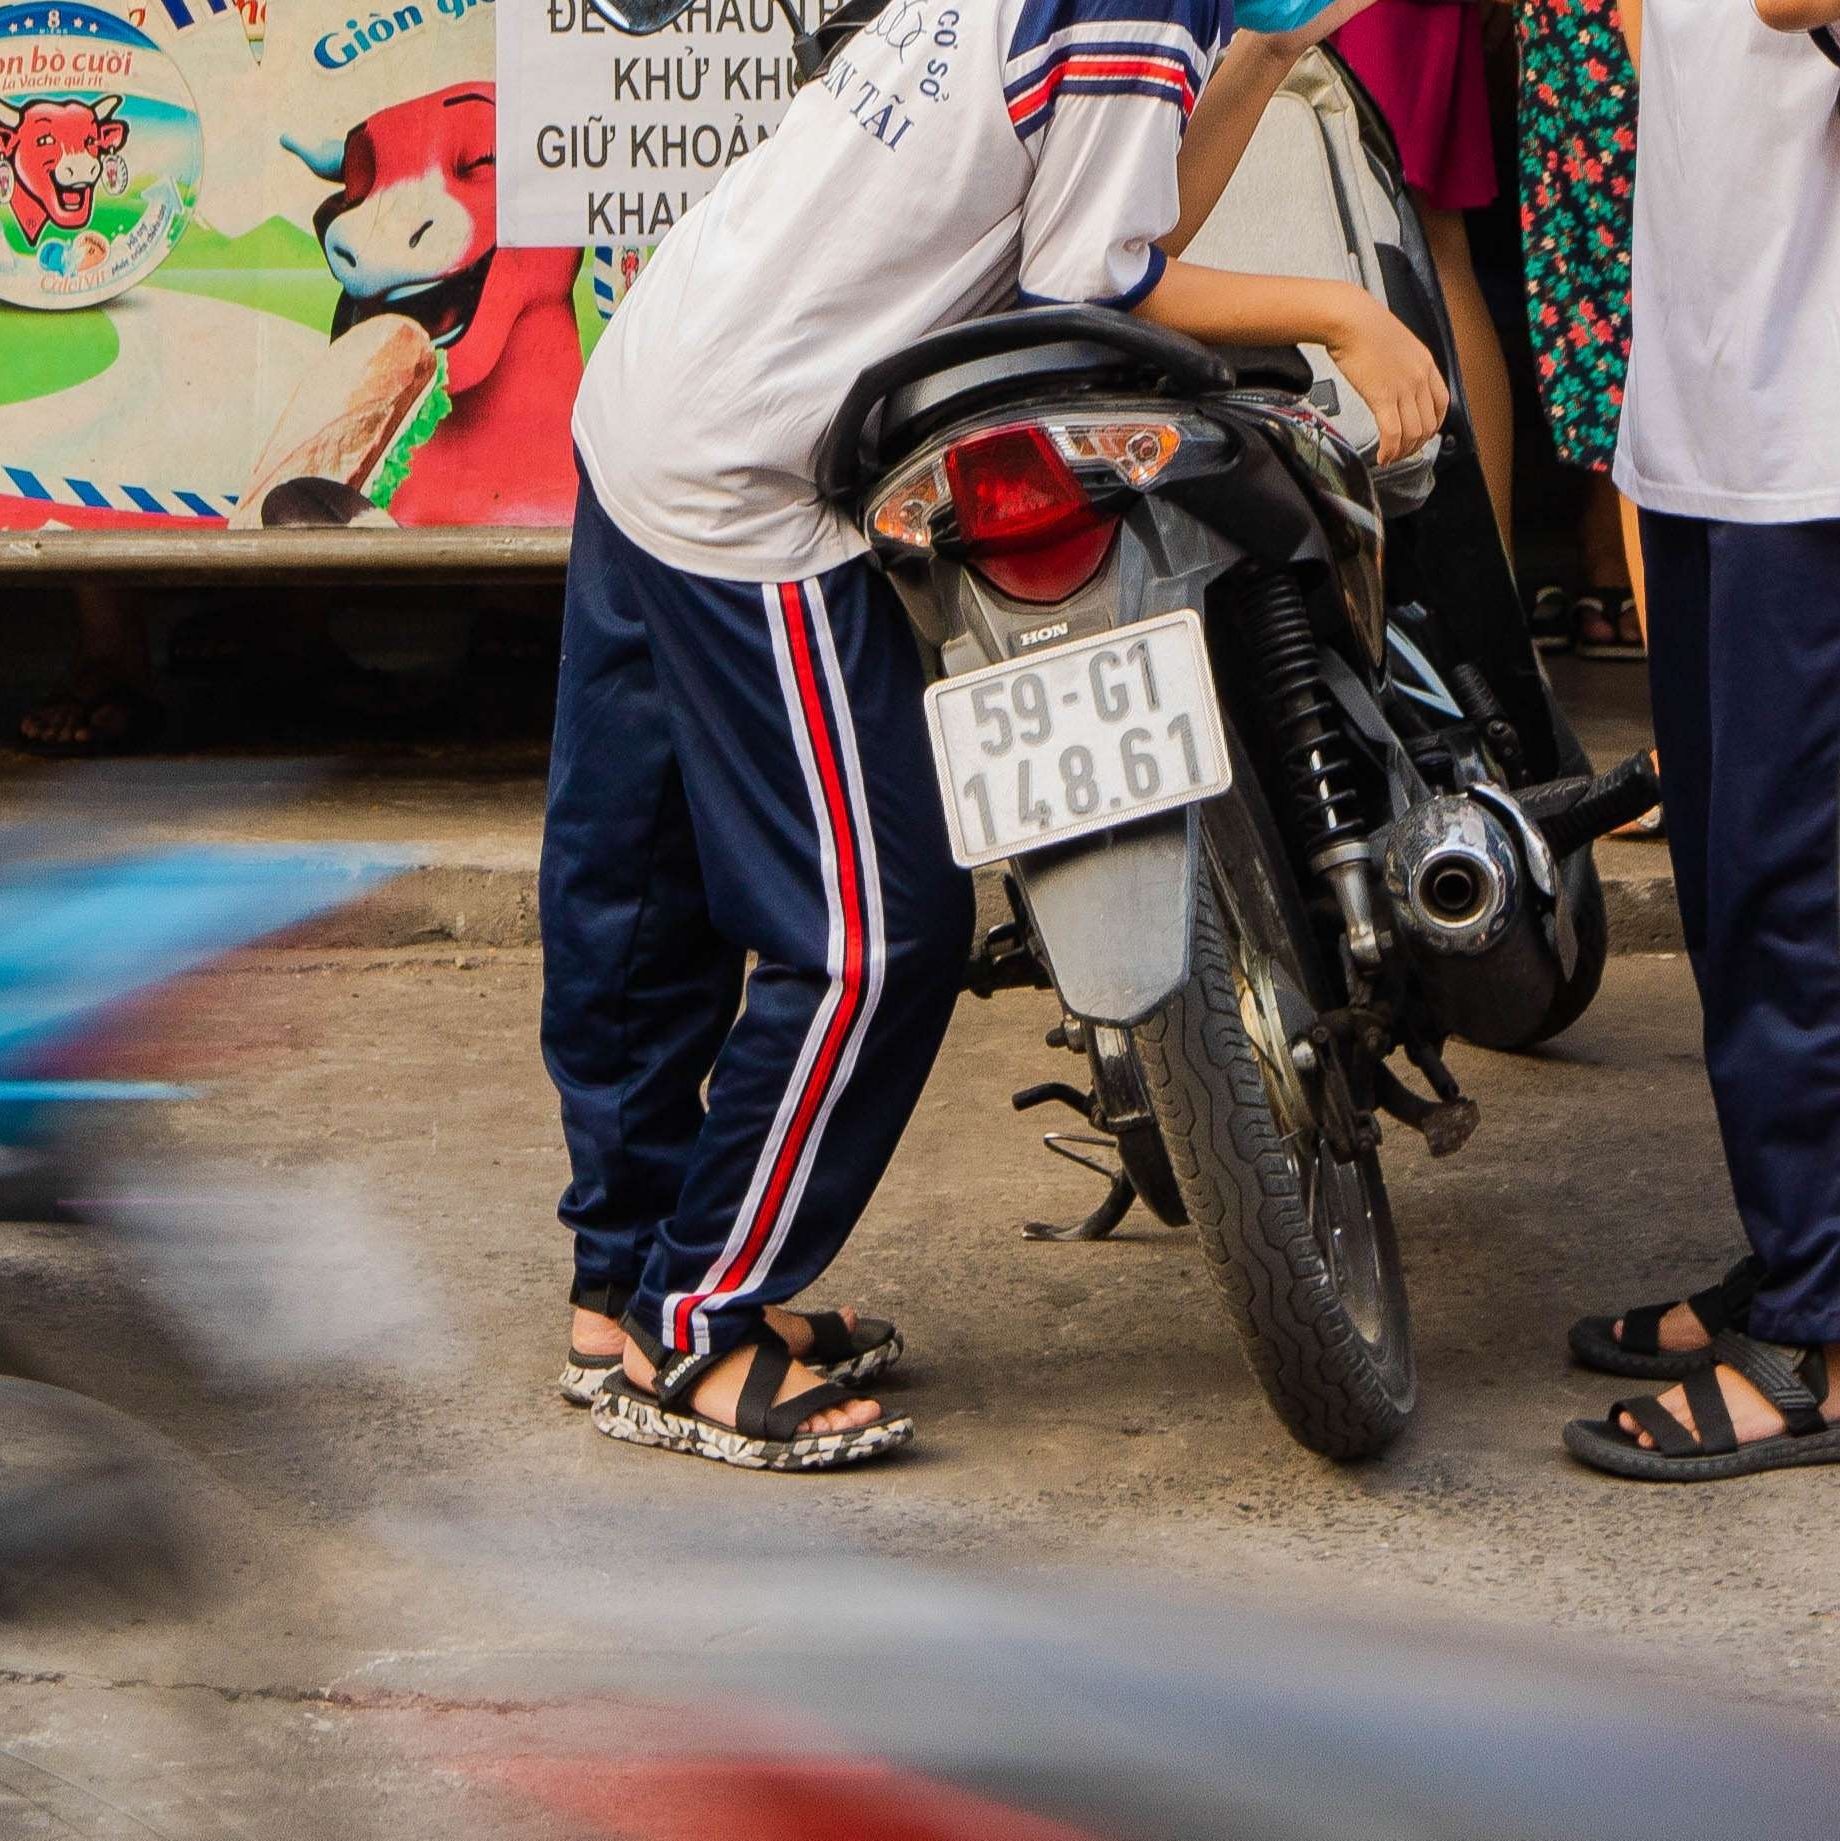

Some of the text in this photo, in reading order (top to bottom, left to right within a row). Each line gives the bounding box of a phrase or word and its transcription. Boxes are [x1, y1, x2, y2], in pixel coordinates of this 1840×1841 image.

[30, 44, 66, 75] bò
[72, 49, 134, 76] cười
[313, 3, 424, 71] Giòn
[614, 46, 710, 101] KHỬ
[536, 115, 616, 169] GIỮ
[970, 638, 1161, 758] 59-G1
[963, 712, 1202, 846] 148.61
